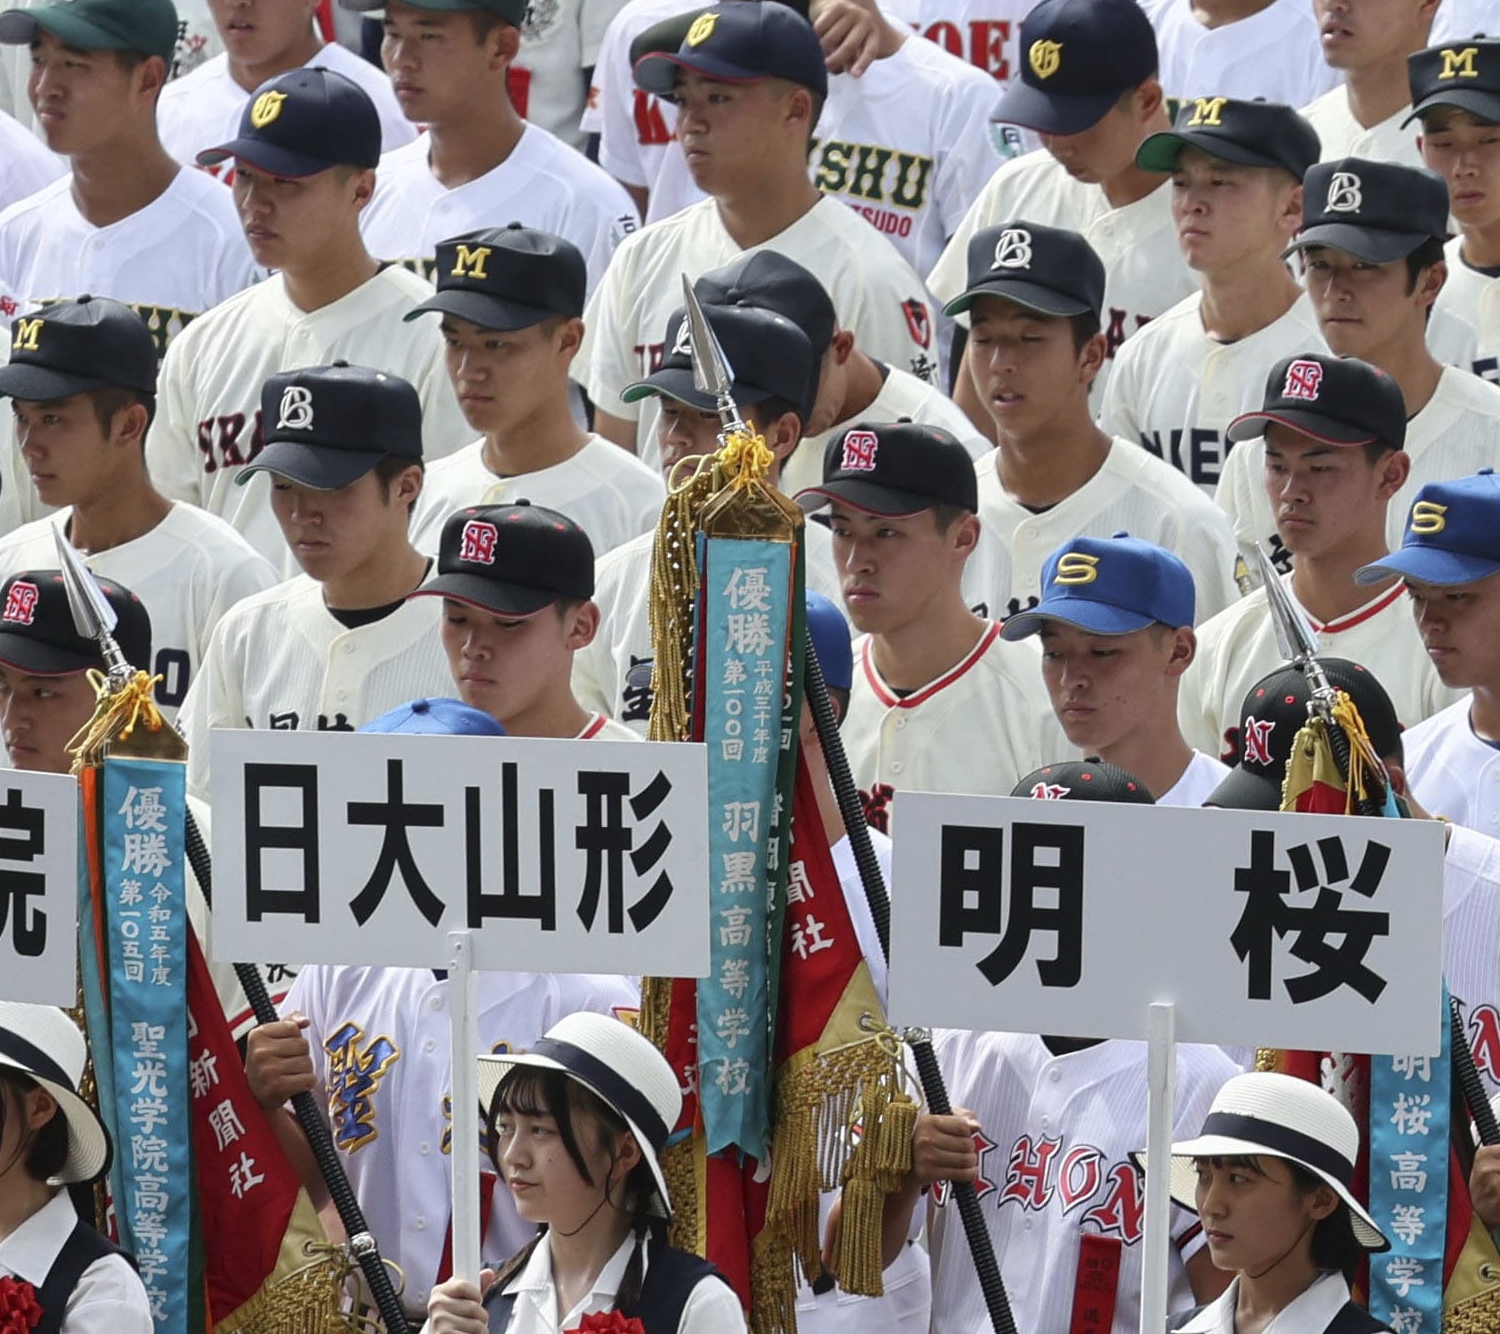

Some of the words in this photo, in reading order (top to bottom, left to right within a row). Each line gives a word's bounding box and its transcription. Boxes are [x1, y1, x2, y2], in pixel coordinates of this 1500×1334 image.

[911, 18, 1018, 81] OE
[1438, 46, 1479, 80] M
[451, 245, 491, 281] M
[1409, 500, 1448, 536] S
[722, 566, 776, 658] 優勝
[1052, 552, 1101, 586] S
[752, 660, 774, 765] 平成三十年度
[118, 785, 173, 878] 優勝
[243, 758, 674, 934] 日大山形
[149, 881, 173, 988] 令和五年度
[714, 800, 762, 1097] 羽黒高等学校
[938, 822, 1391, 1006] 明桜
[322, 1020, 401, 1154] 聖
[129, 1020, 170, 1323] 聖光学院高等学校
